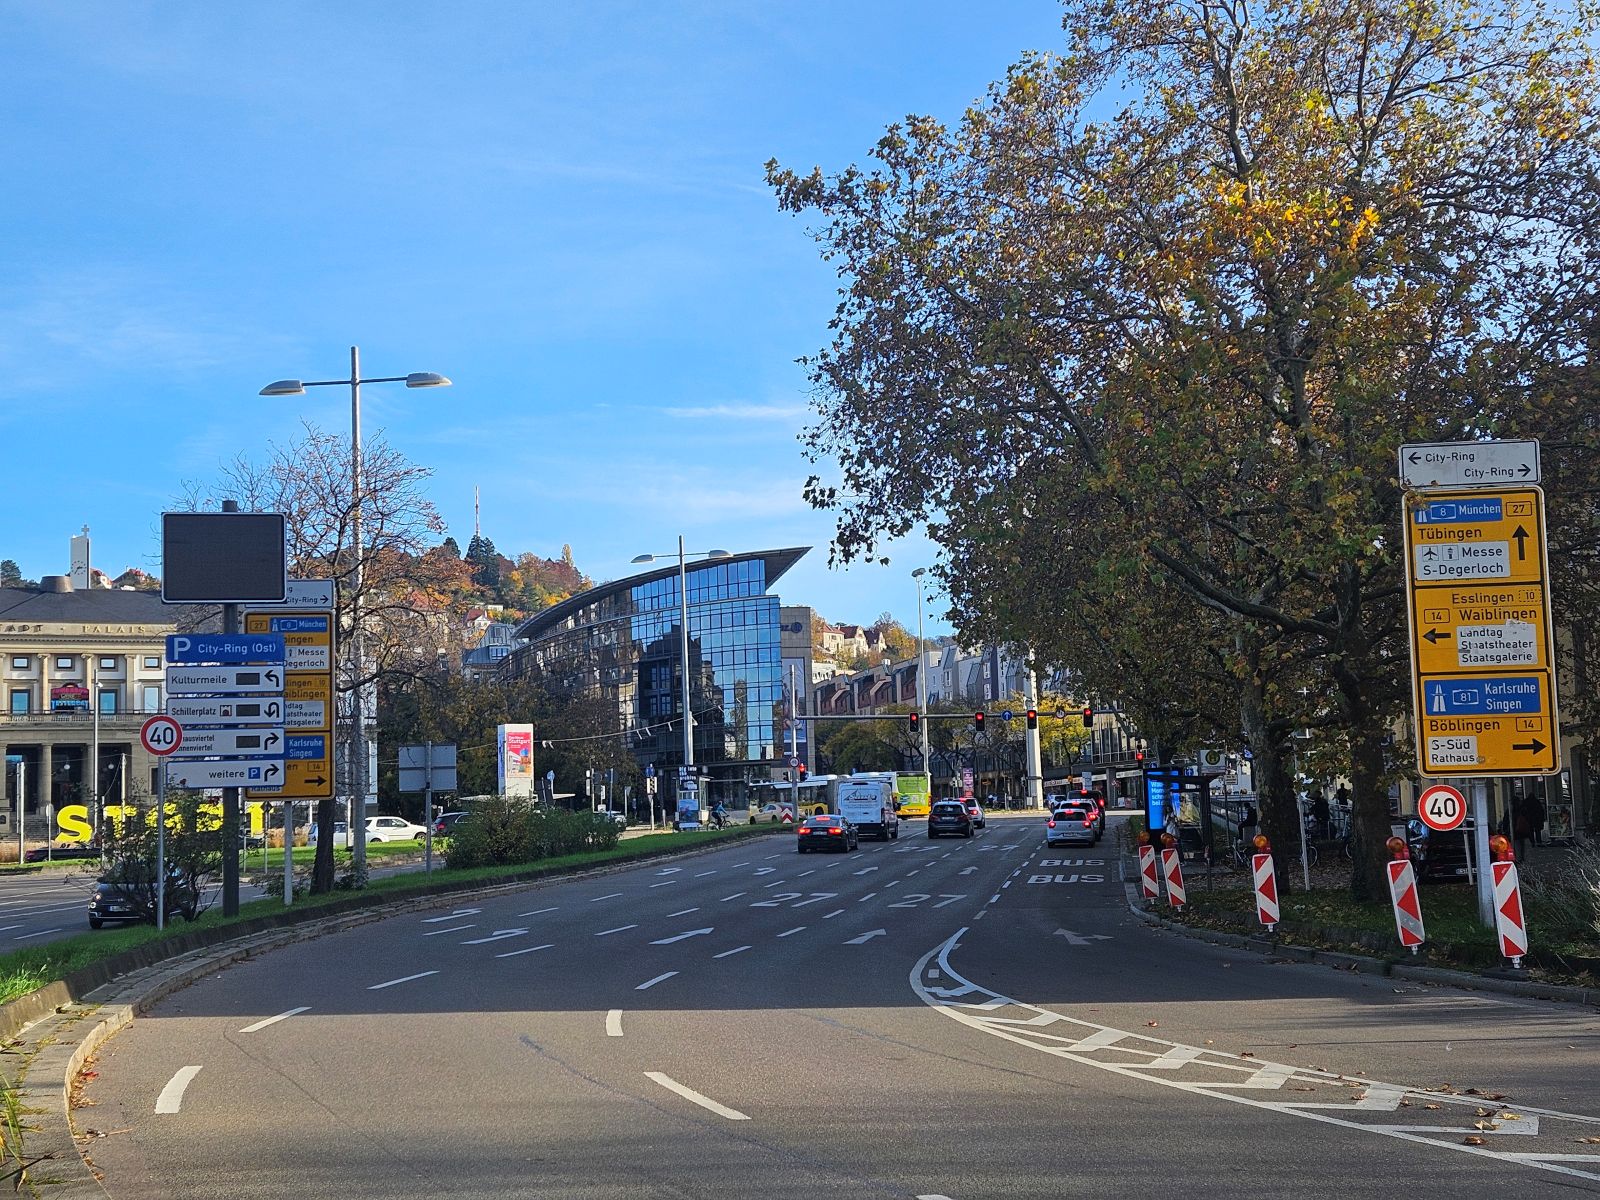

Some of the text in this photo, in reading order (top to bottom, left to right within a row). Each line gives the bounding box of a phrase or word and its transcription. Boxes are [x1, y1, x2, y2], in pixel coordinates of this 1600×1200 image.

[1425, 452, 1475, 463] City-Ring
[1464, 467, 1514, 479] City-Ring
[1440, 504, 1501, 516] 8 München
[1512, 505, 1525, 514] 27
[1418, 528, 1482, 541] Tübingen
[1462, 547, 1503, 558] Messe
[1423, 562, 1503, 577] S-Degerloch
[1452, 592, 1535, 606] Esslingen 10
[1431, 608, 1537, 621] 14 Waiblingen
[0, 624, 145, 633] ADT PALAIS
[298, 620, 327, 629] München
[1460, 628, 1503, 639] Landtag
[284, 635, 313, 644] ingen
[173, 637, 276, 660] P City-Ring (Ost)
[1462, 652, 1533, 664] Staatsgalerie
[171, 675, 227, 685] Kulturmeile
[286, 679, 312, 687] lingen
[284, 689, 325, 699] aiblingen
[1460, 682, 1536, 701] 81 Karlsruhe
[1486, 699, 1522, 712] Singen
[171, 707, 217, 716] Schillerplatz
[283, 719, 322, 727] aatsgalerie
[1430, 719, 1534, 733] Böblingen 14
[150, 727, 174, 745] 40
[183, 734, 215, 742] ausviertel
[289, 738, 323, 747] Karlsruhe
[1432, 739, 1470, 750] S-Süd
[289, 748, 313, 759] Singen
[1431, 753, 1475, 763] Rathaus
[209, 770, 245, 779] weitere
[1429, 798, 1457, 818] 40
[1027, 874, 1104, 884] BUS
[750, 893, 838, 908] 27
[887, 894, 967, 908] 27
